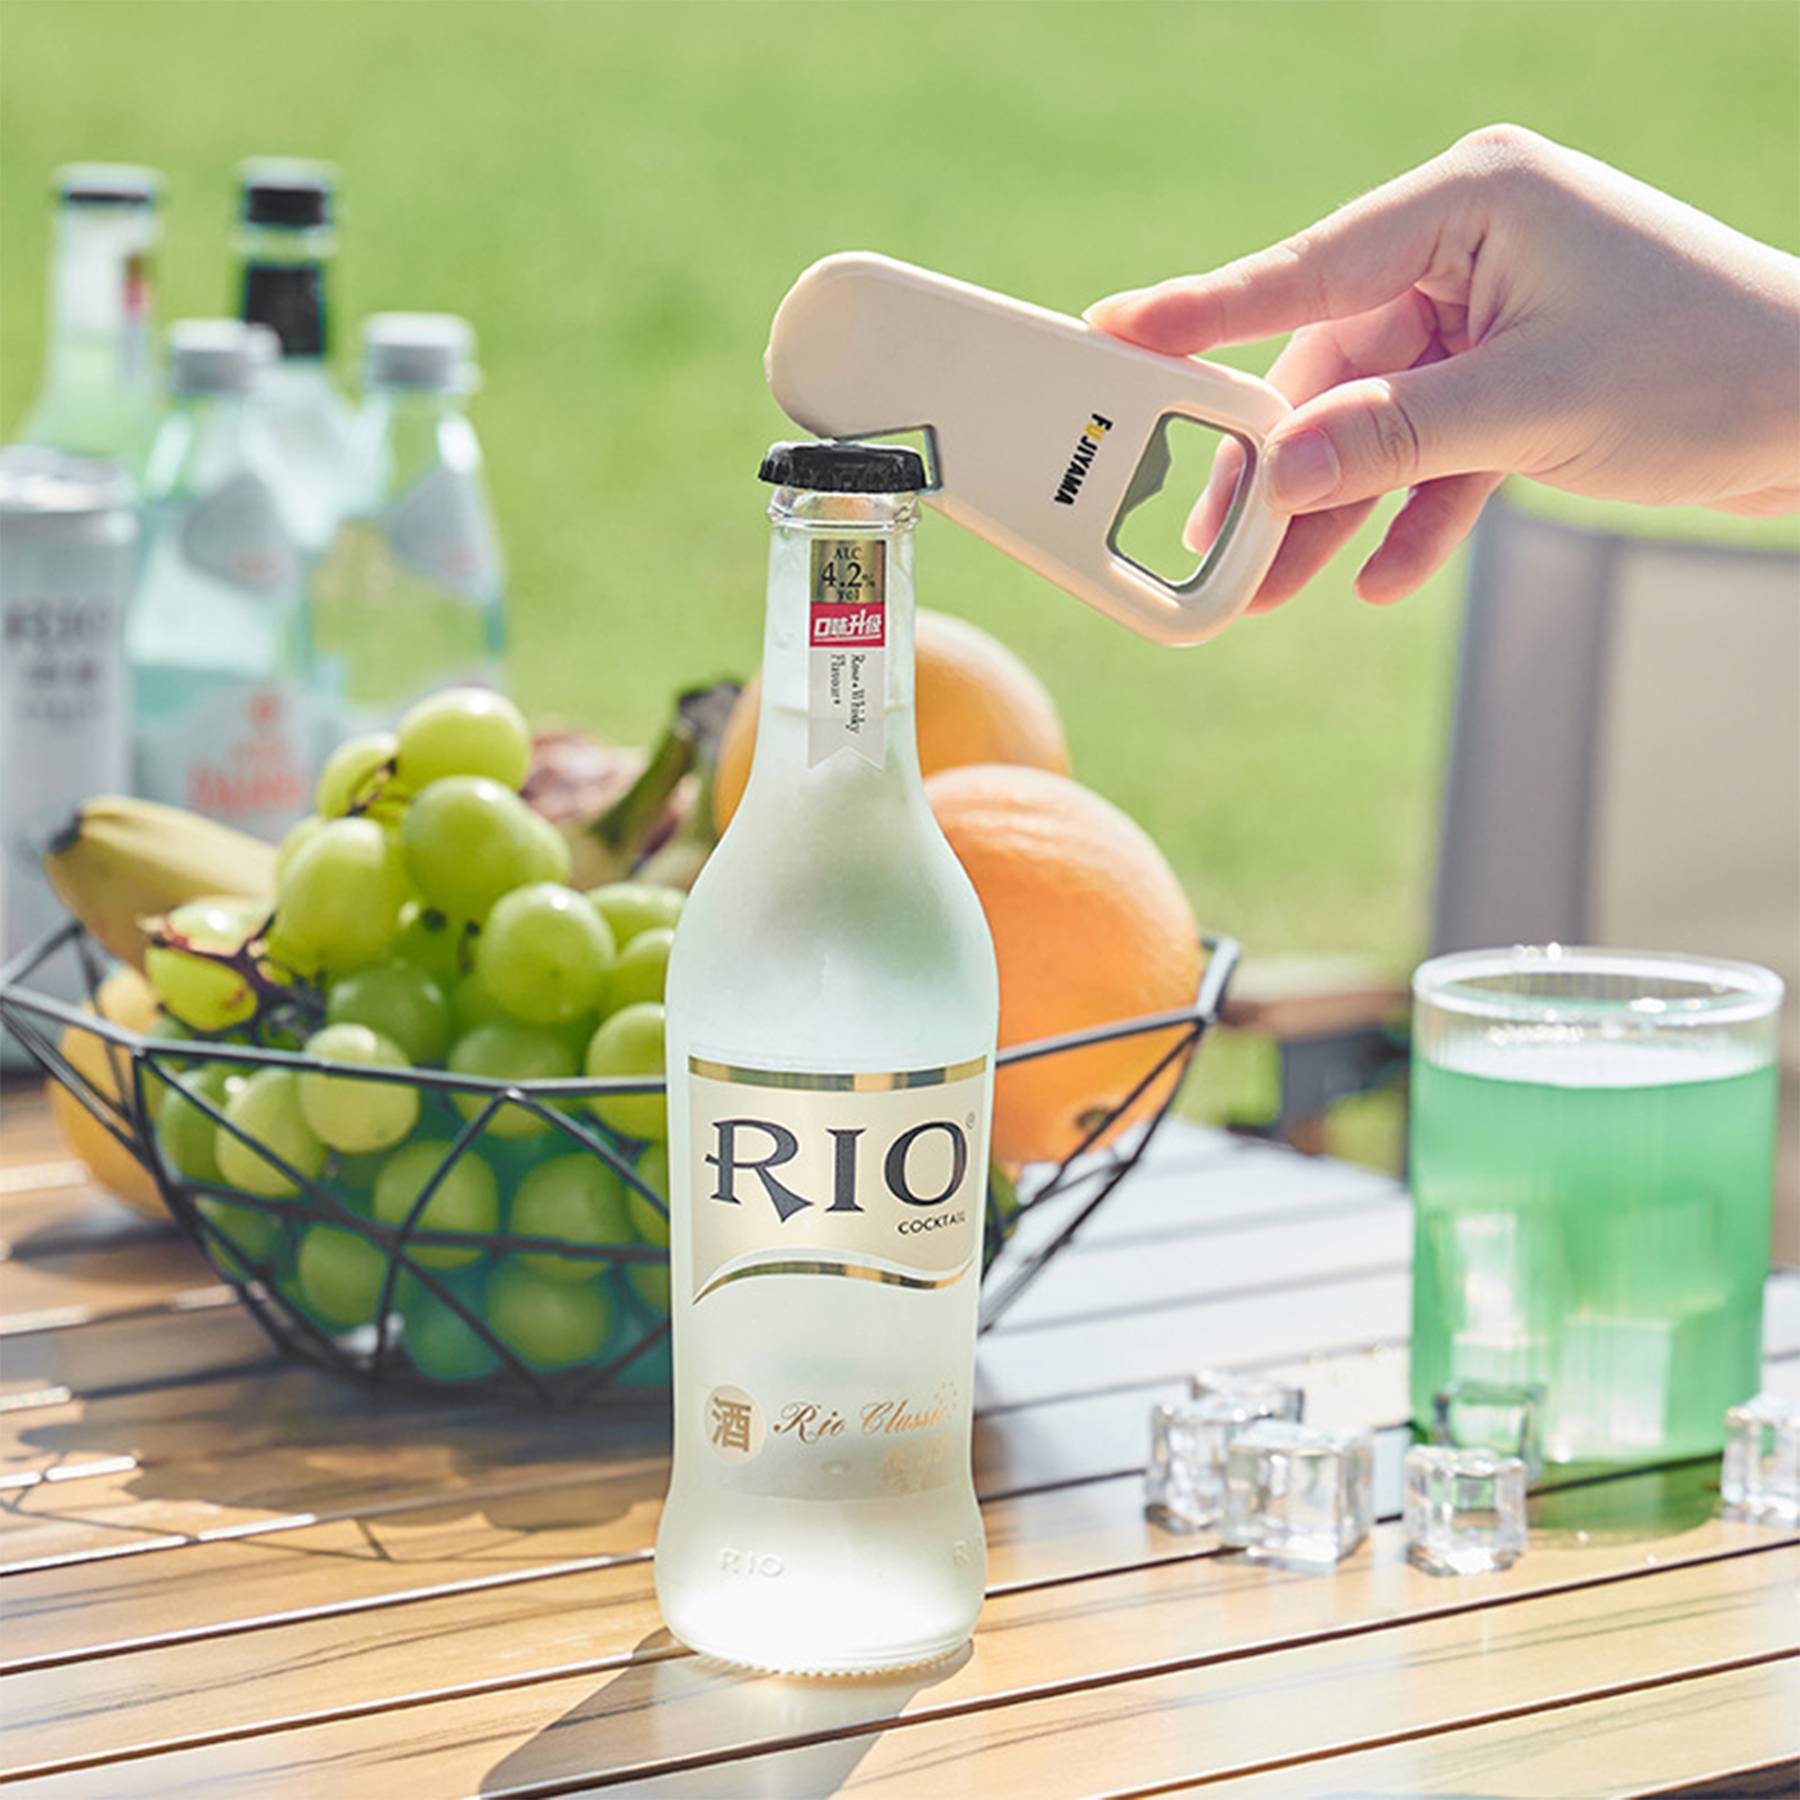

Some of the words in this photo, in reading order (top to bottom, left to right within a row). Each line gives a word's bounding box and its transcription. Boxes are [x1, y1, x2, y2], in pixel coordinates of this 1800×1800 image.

[1053, 413, 1113, 505] FUJIYAMA
[834, 546, 862, 560] ALC
[821, 561, 875, 588] 4.2%
[814, 608, 881, 637] 口味升级
[705, 1119, 968, 1223] RIO
[711, 1396, 751, 1452] 酒
[773, 1401, 847, 1445] Rio
[719, 1546, 785, 1578] RIO
